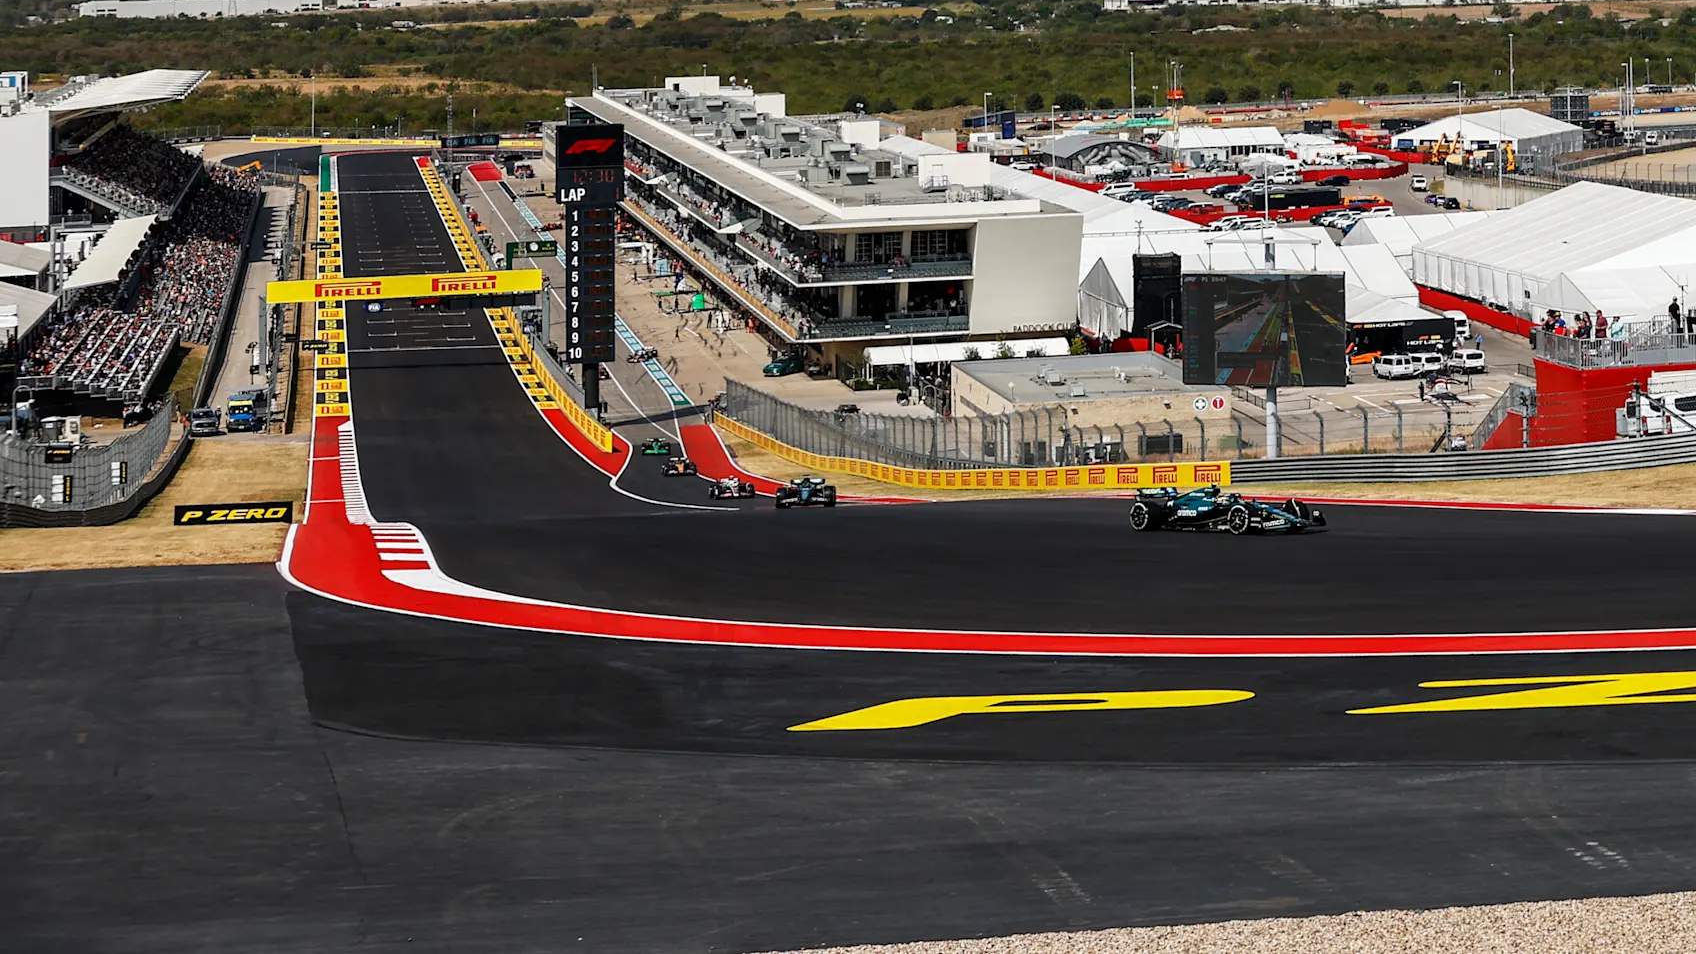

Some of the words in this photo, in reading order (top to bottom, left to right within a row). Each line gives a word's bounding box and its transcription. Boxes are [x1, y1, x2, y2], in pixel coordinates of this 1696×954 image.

[573, 169, 615, 183] 12:30
[560, 188, 586, 202] LAP
[572, 210, 578, 221] 1
[571, 226, 579, 237] 2
[571, 241, 579, 252] 3
[571, 256, 579, 267] 4
[571, 271, 579, 282] 5
[315, 281, 382, 296] PIRELLI
[432, 275, 497, 292] PIRELLI
[571, 286, 579, 298] 6
[571, 301, 579, 313] 7
[571, 317, 579, 328] 8
[1013, 323, 1054, 333] PADDOCK
[571, 332, 579, 344] 9
[568, 347, 582, 359] 10
[1089, 468, 1105, 485] PIRELLI
[1118, 467, 1138, 484] PIRELLI
[1153, 466, 1177, 484] PIRELLI
[1194, 465, 1221, 483] PIRELLI
[180, 511, 203, 522] P
[206, 507, 287, 521] ZERO
[788, 689, 1255, 731] P
